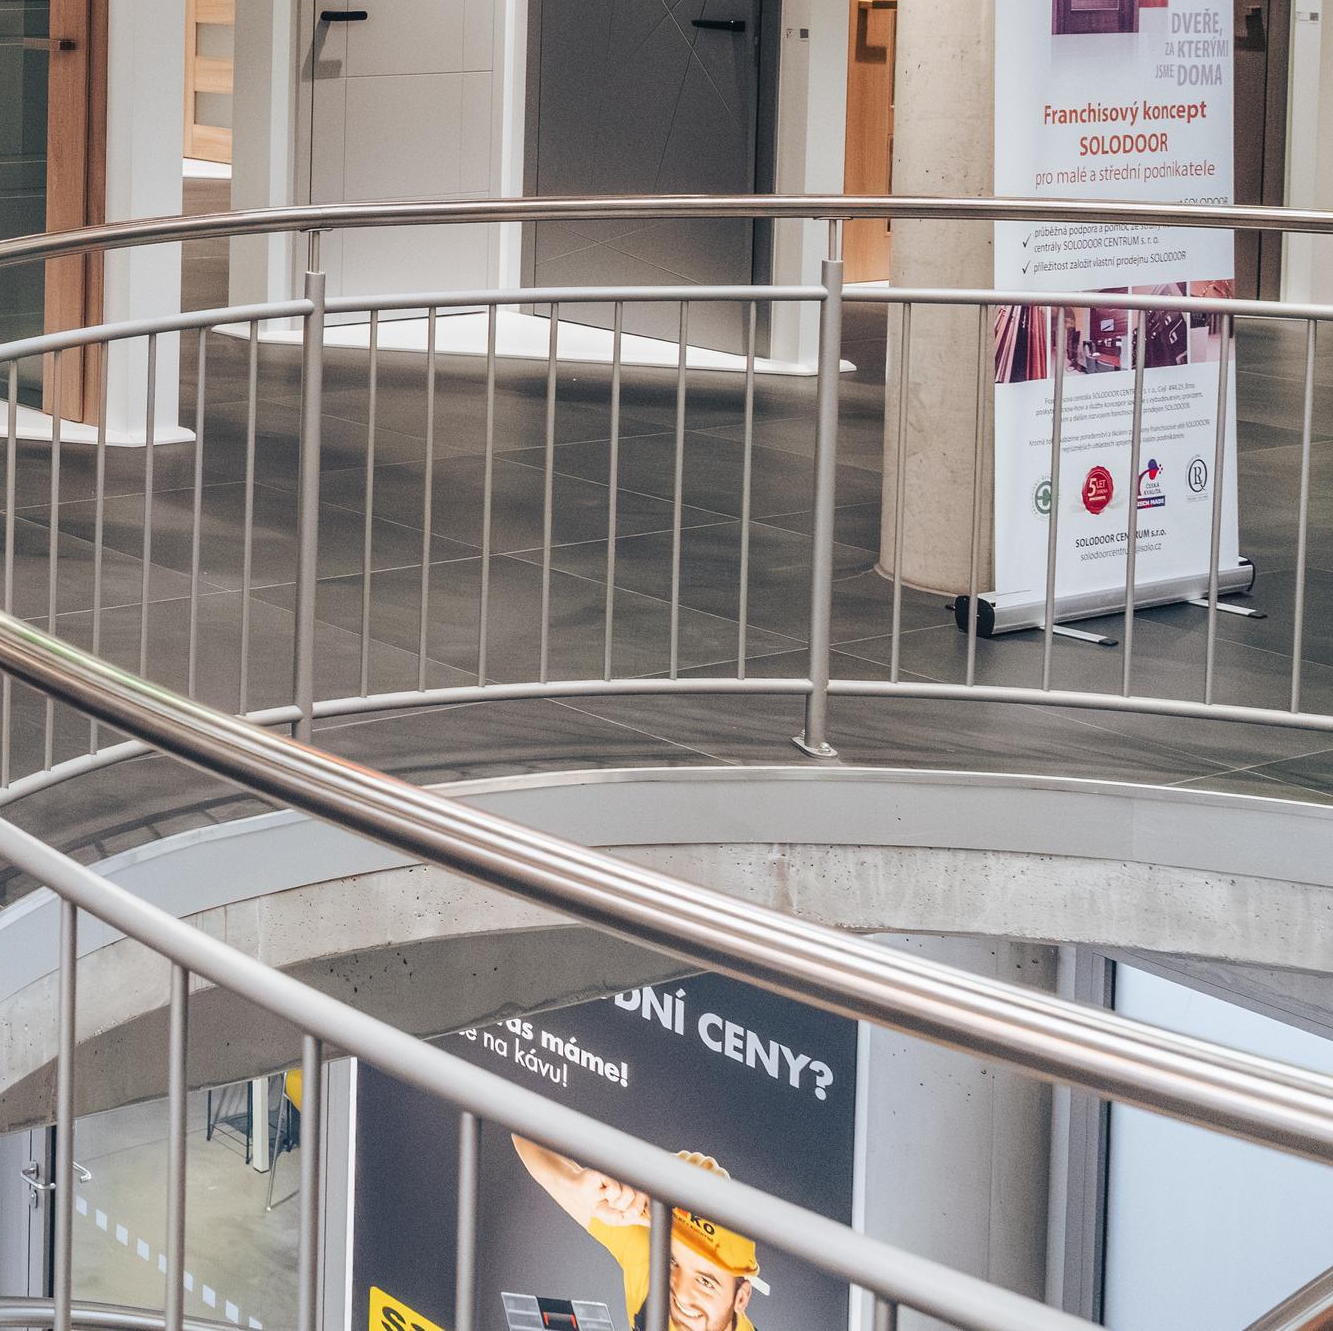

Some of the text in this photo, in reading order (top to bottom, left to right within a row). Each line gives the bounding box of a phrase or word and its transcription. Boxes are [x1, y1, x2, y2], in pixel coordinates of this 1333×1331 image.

[1171, 9, 1223, 35] DVEŘE,
[1165, 37, 1229, 58] ZA KTERÝMI
[1155, 64, 1223, 86] JSME DOMA
[1044, 101, 1207, 126] Franchisový koncept
[1079, 132, 1169, 156] SOLODOOR
[1035, 160, 1215, 190] pro malé a střední podnikatele
[1063, 238, 1103, 251] SOLODOOR
[1104, 236, 1140, 248] CENTRUM
[1150, 250, 1186, 263] SOLODOOR
[1075, 533, 1115, 548] SOLODOOR
[1116, 528, 1150, 543] CENRUM
[483, 1031, 508, 1058] na
[514, 1037, 569, 1088] kávu!
[541, 1030, 629, 1088] máme!
[697, 1012, 835, 1101] CENY?
